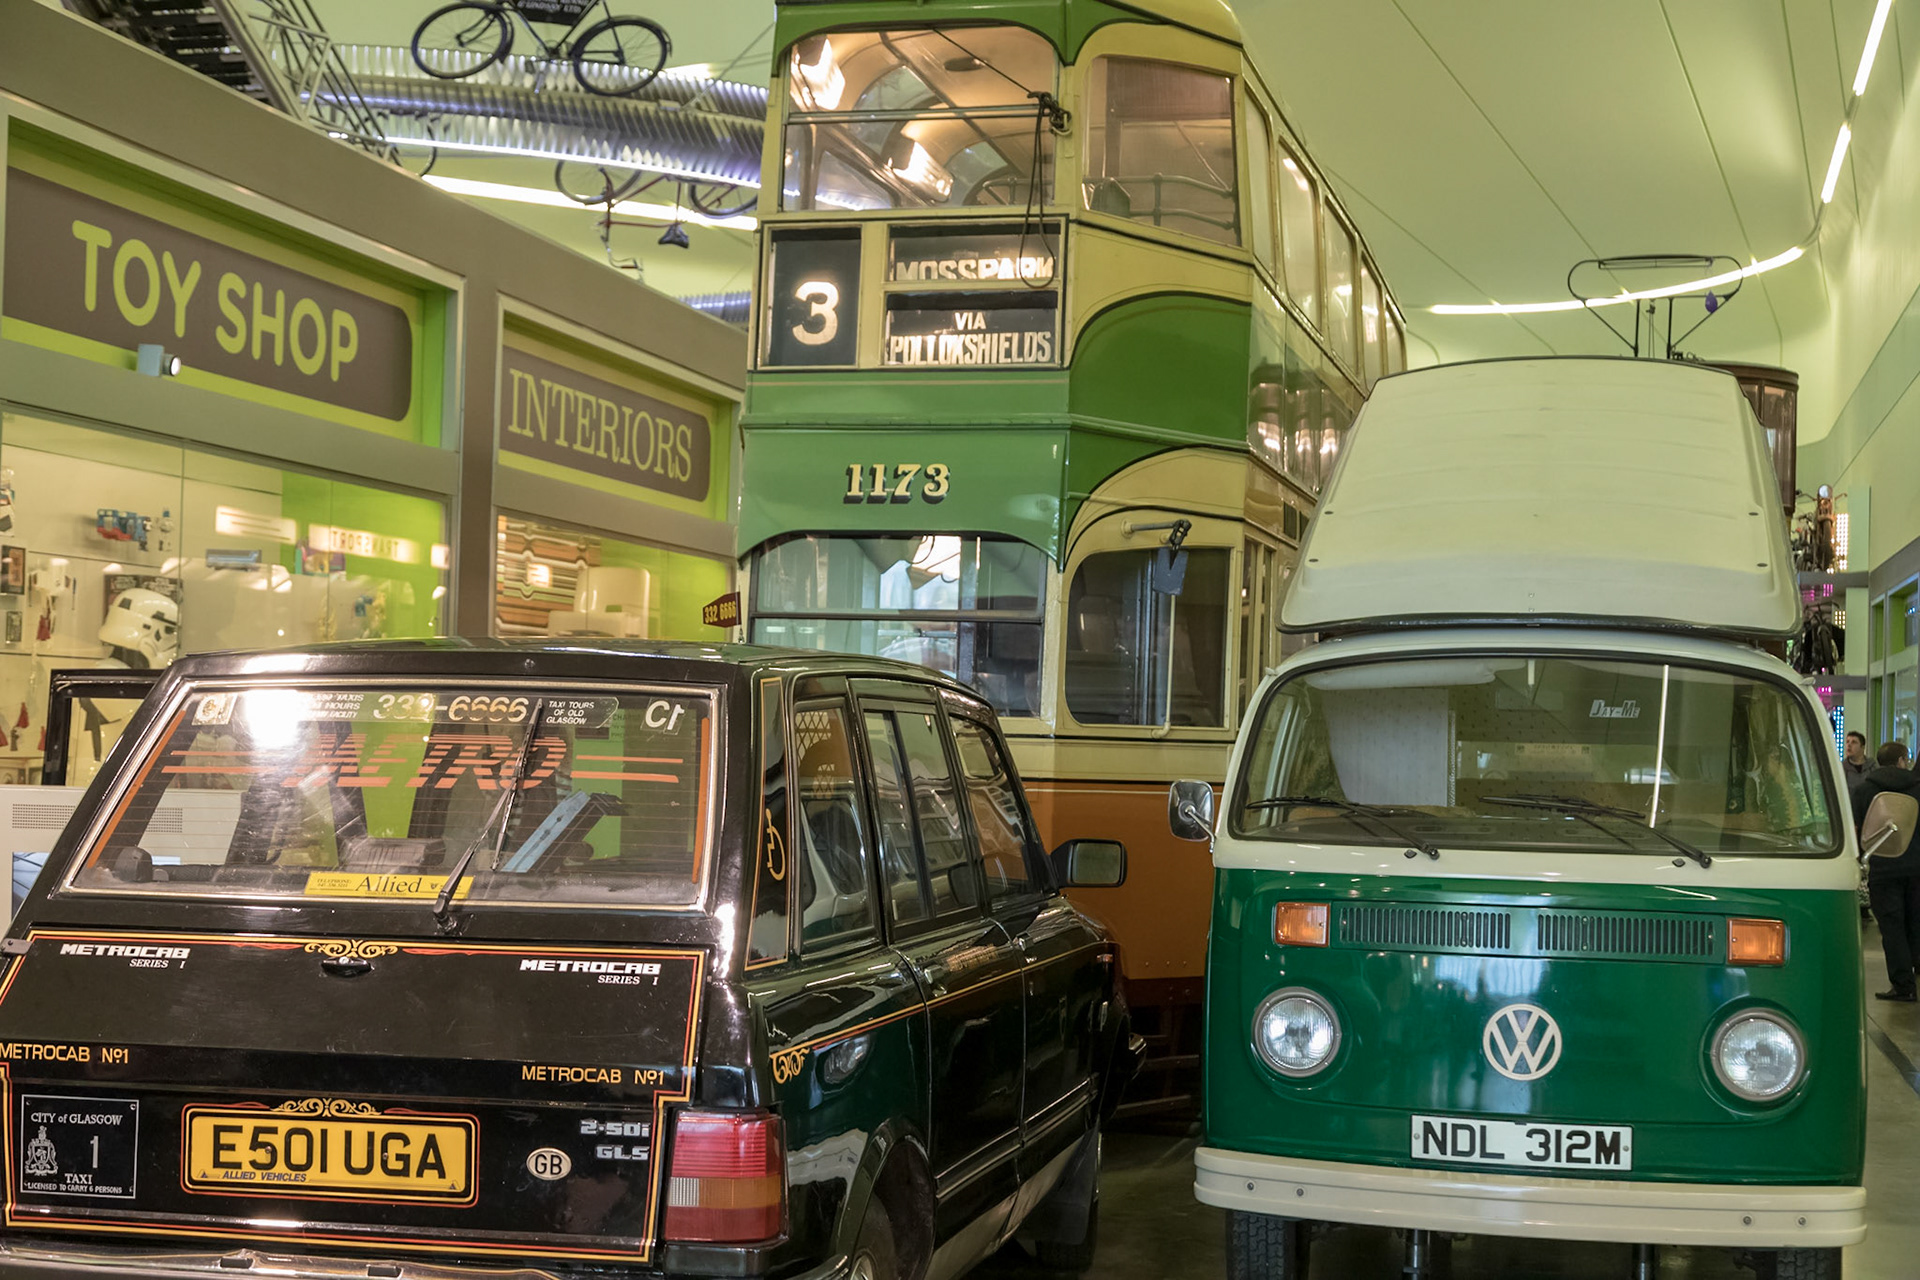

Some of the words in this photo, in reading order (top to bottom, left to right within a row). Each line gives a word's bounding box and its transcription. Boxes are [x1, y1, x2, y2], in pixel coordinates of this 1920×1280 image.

[72, 220, 201, 338] TOY
[215, 272, 359, 382] SHOP
[792, 281, 839, 345] 3
[955, 312, 986, 331] VIA
[890, 332, 1052, 365] POLLOKSHIELDS
[508, 368, 692, 482] INTERIORS
[844, 463, 950, 503] 1173
[705, 605, 718, 623] 332
[720, 601, 736, 620] 6666
[325, 702, 361, 710] HOURS
[567, 709, 585, 717] OLD
[569, 701, 595, 709] TOURS
[546, 716, 587, 725] GLASGOW
[355, 876, 422, 894] Allied
[60, 943, 191, 959] METROCAB
[129, 959, 169, 969] SERIES
[520, 959, 662, 975] METROCAB
[597, 974, 640, 985] SERIES
[1483, 1004, 1562, 1081] VW
[0, 1043, 91, 1062] METROCAB
[521, 1065, 622, 1084] METROCAB
[30, 1112, 56, 1124] CITY
[57, 1114, 68, 1123] of
[69, 1114, 123, 1126] GLASGOW
[90, 1135, 99, 1169] 1
[213, 1124, 328, 1174] E501
[343, 1130, 447, 1179] UGA
[1422, 1121, 1505, 1160] NDL
[1525, 1128, 1621, 1165] 312M
[596, 1144, 650, 1161] GLS
[534, 1153, 563, 1176] GB
[64, 1173, 93, 1185] TAXI
[222, 1170, 256, 1181] ALLIED
[260, 1171, 307, 1183] VEHICLES
[27, 1182, 58, 1191] LICENSED
[59, 1183, 67, 1191] TO
[67, 1184, 88, 1193] CARRY
[88, 1185, 94, 1193] 6
[94, 1186, 123, 1194] PERSONS
